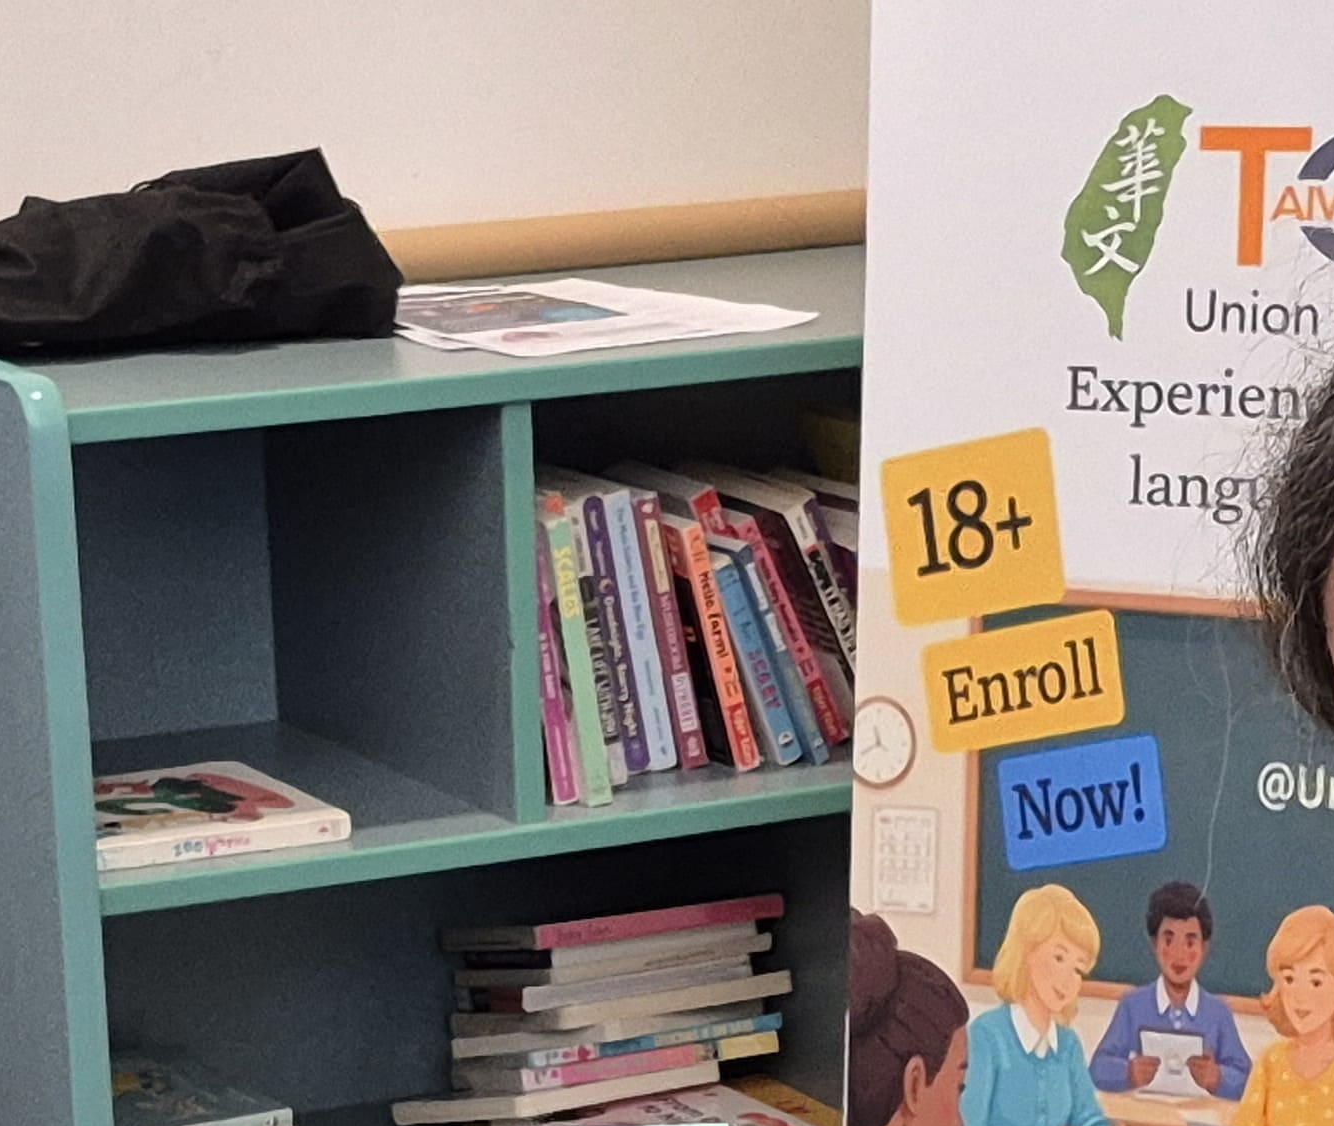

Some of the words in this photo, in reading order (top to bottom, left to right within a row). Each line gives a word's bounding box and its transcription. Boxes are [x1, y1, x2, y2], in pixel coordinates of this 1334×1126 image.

[1185, 288, 1319, 336] Union
[906, 479, 1033, 578] 18+
[942, 637, 1104, 726] Enroll
[1013, 763, 1147, 841] Now!
